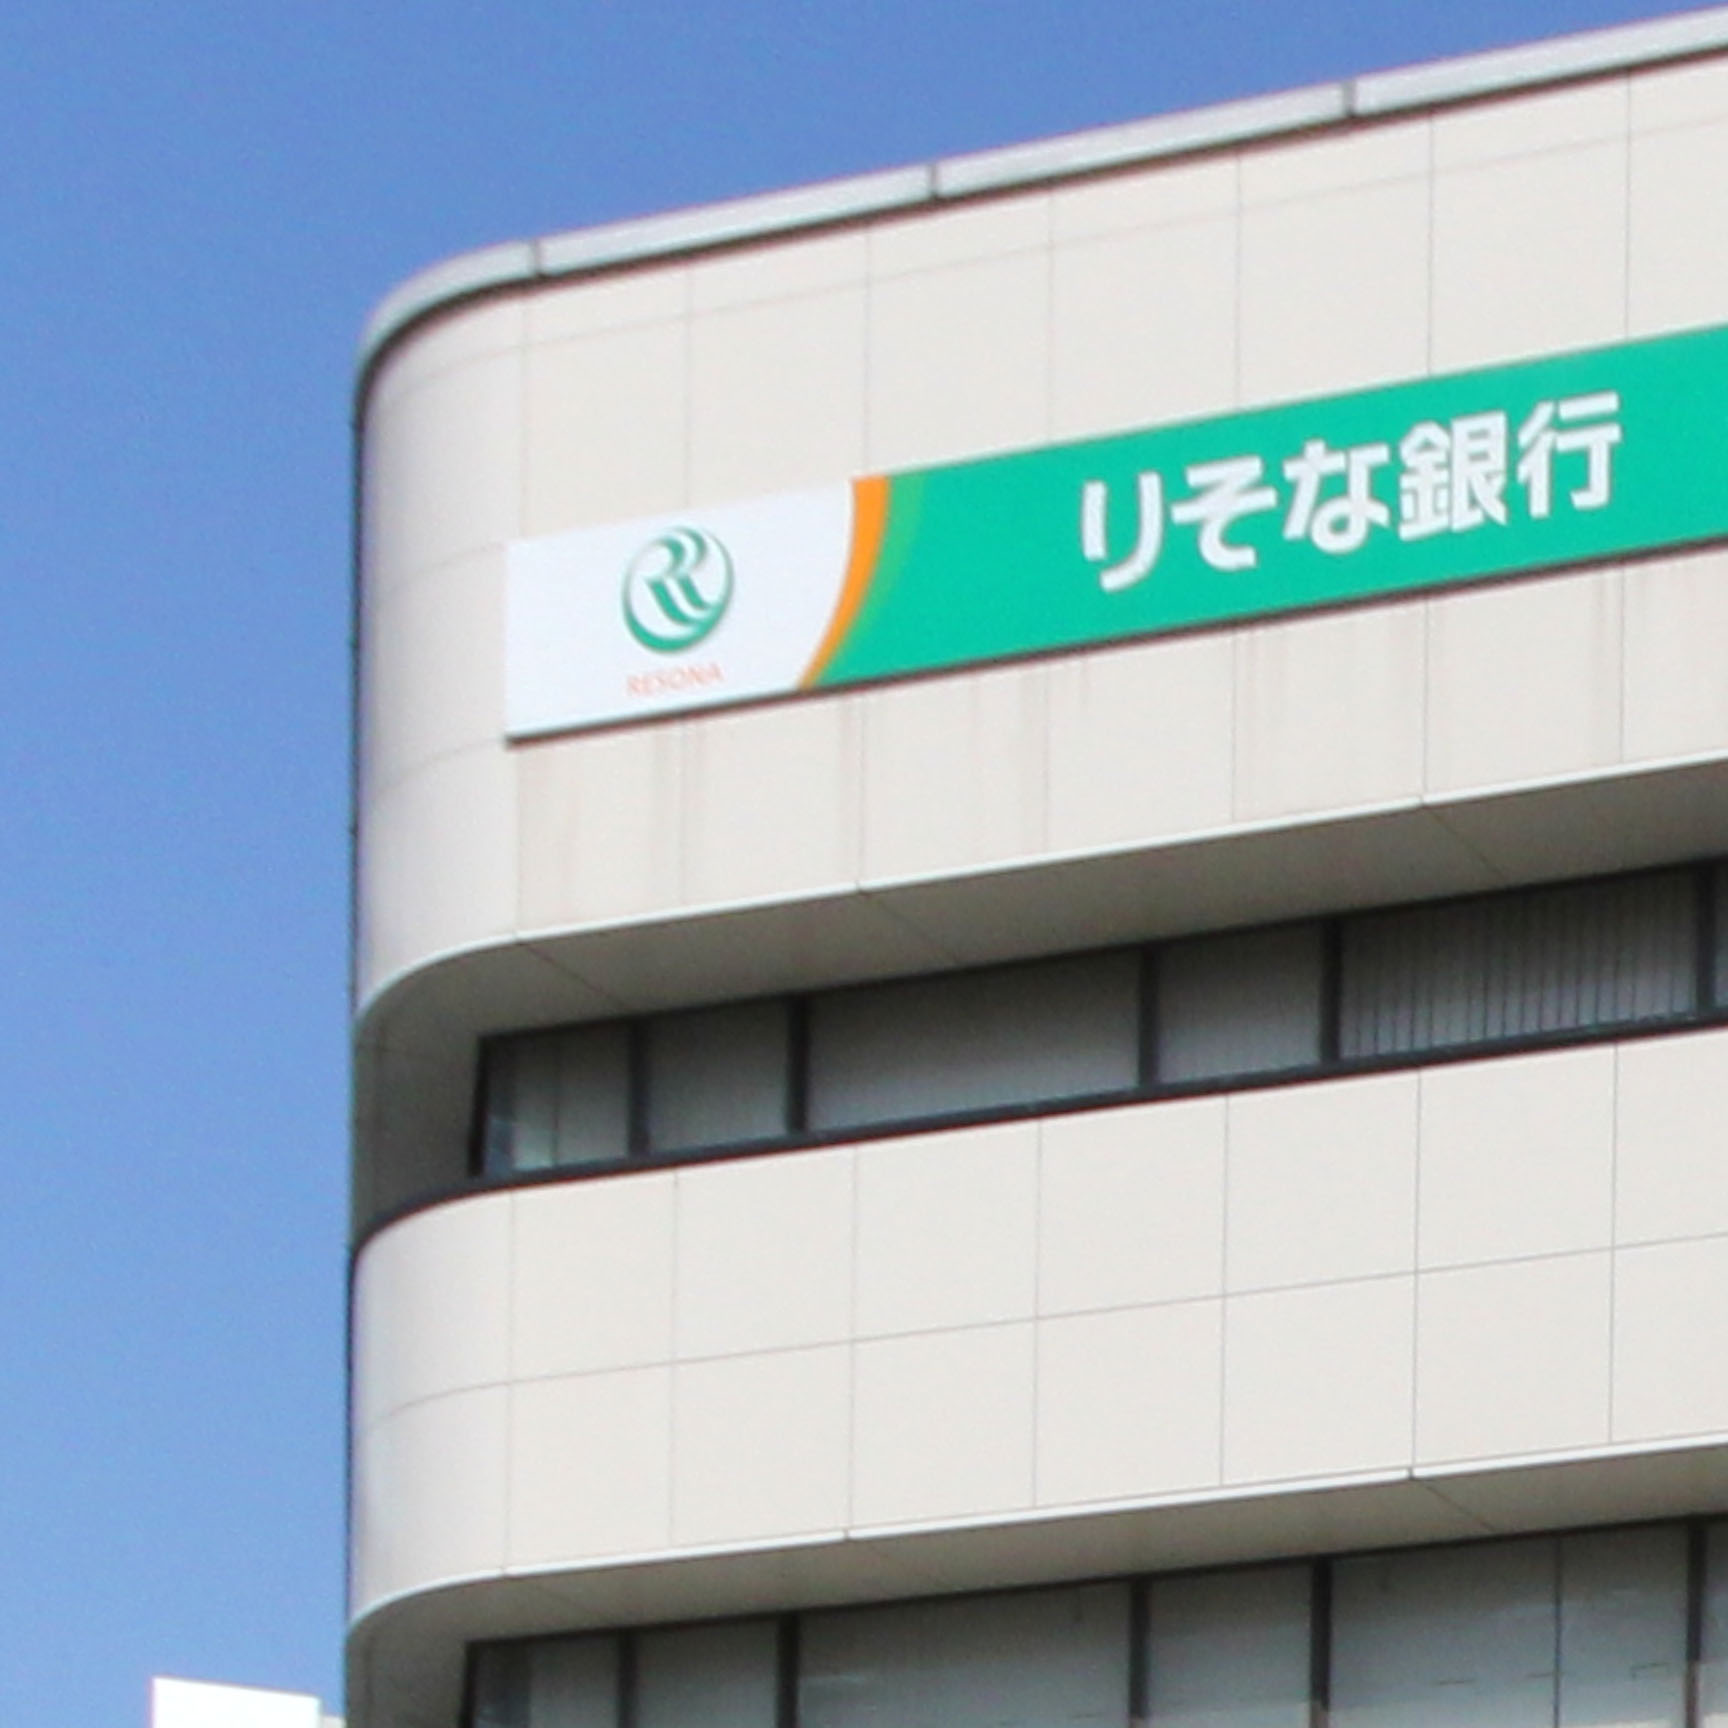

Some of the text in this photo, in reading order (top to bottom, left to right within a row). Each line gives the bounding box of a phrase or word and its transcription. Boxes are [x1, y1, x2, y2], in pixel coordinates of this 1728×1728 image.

[1081, 391, 1622, 592] りそな銀行
[626, 662, 724, 697] RESONA
